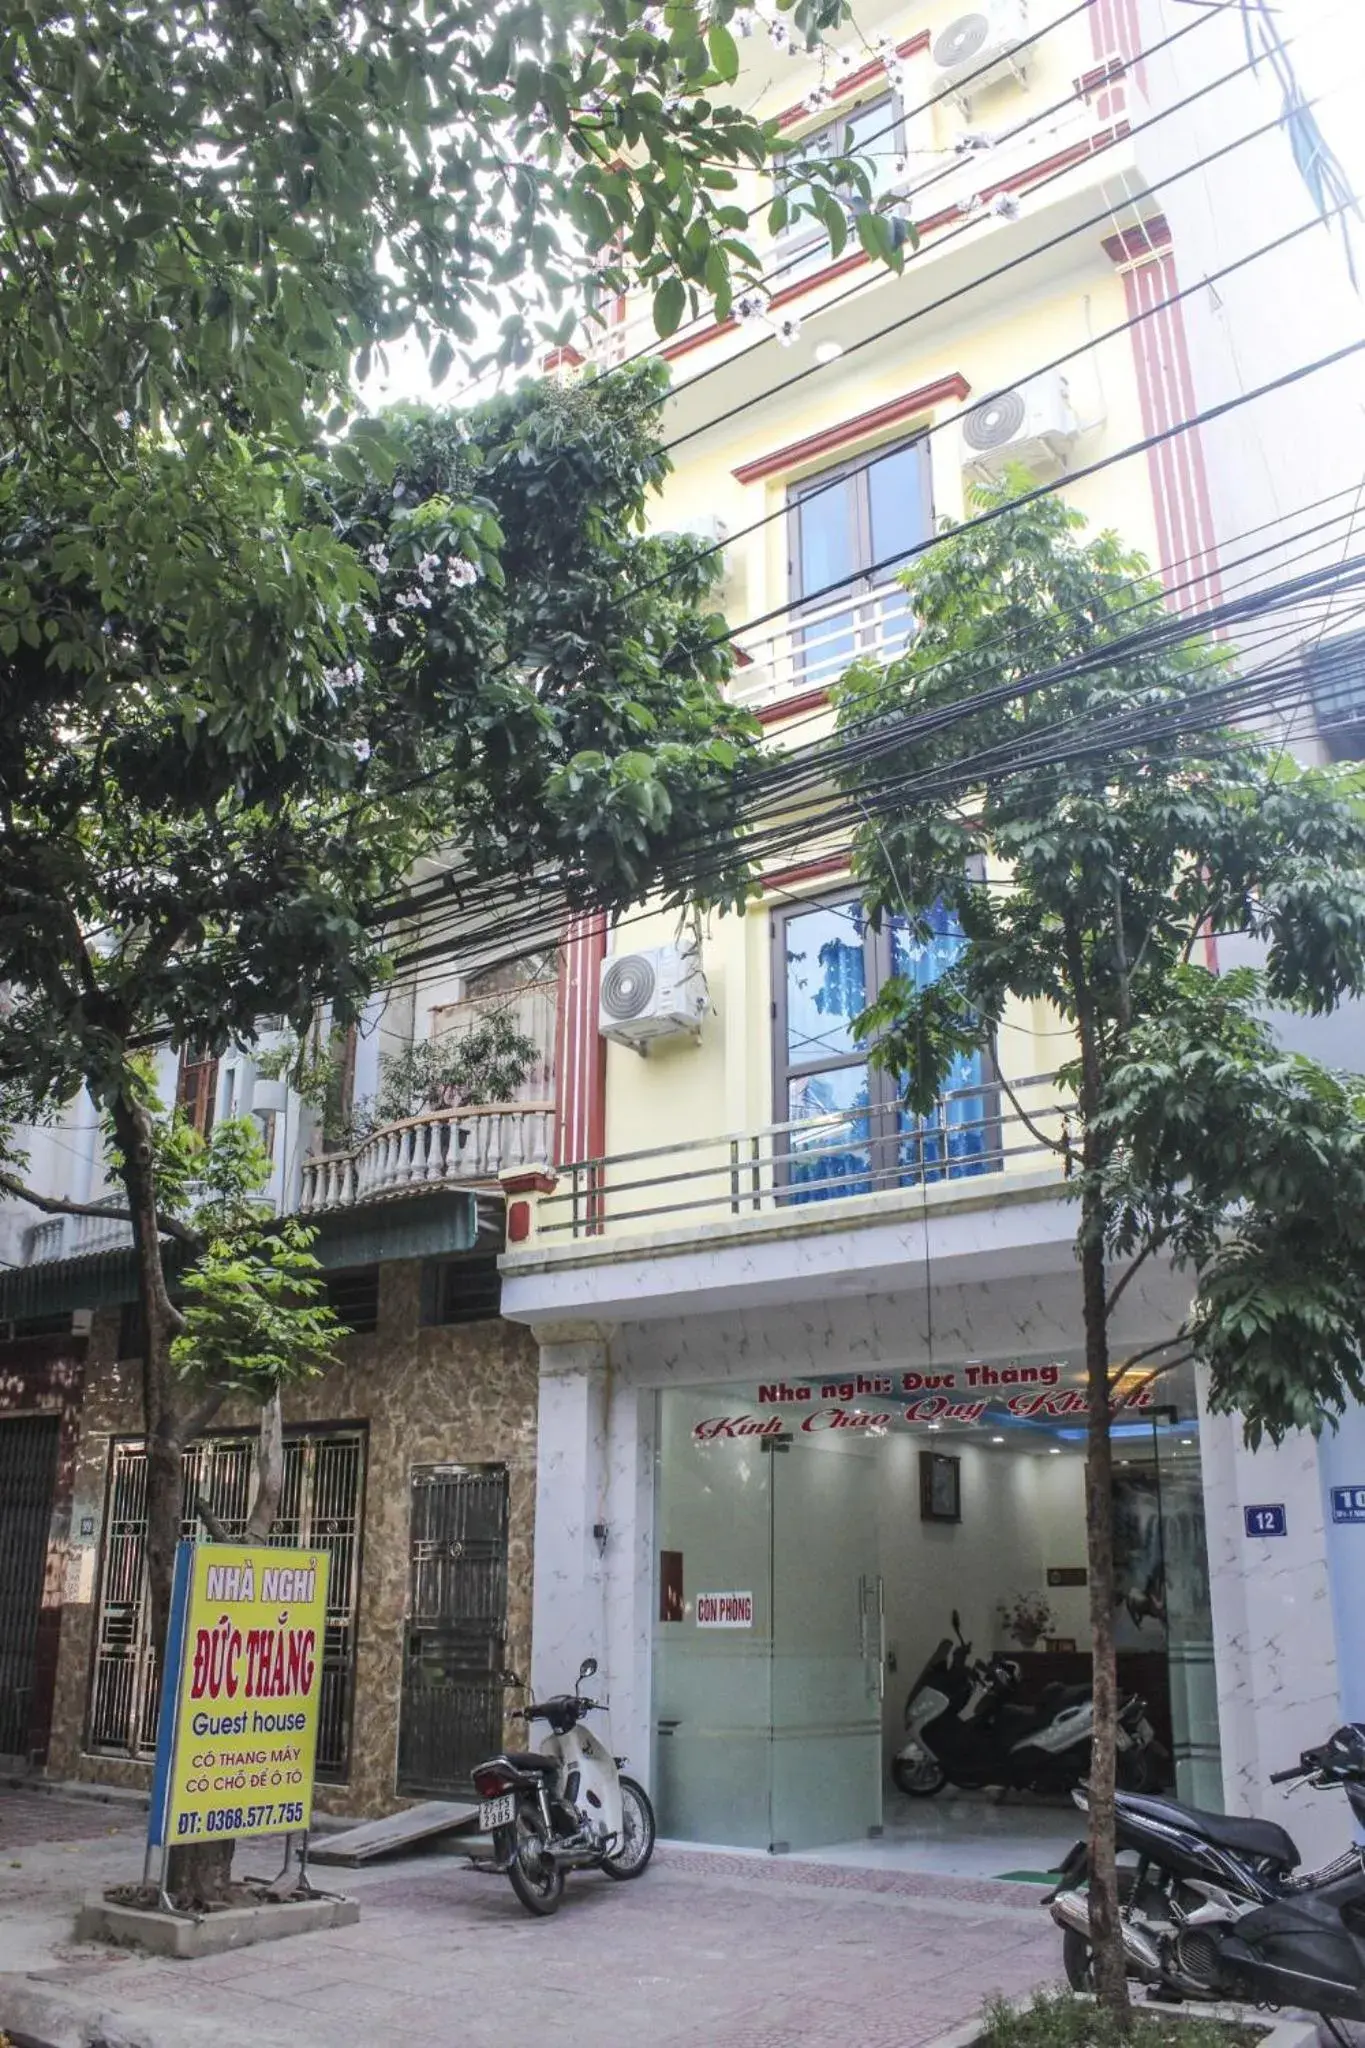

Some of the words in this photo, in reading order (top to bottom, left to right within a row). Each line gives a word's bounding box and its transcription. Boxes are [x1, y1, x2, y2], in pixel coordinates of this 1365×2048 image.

[1255, 1512, 1275, 1530] 12
[206, 1559, 255, 1602] NHÀ
[261, 1556, 318, 1603] NGHỈ
[191, 1614, 242, 1699] ĐỨC
[245, 1610, 315, 1698] THẮNG
[192, 1711, 248, 1736] Guest
[252, 1710, 306, 1733] house
[192, 1750, 216, 1768] CÓ
[219, 1751, 267, 1767] THANG
[270, 1745, 301, 1763] MÁY
[186, 1774, 210, 1793] CÓ
[213, 1769, 247, 1791] CHỖ
[271, 1769, 282, 1786] Ô
[286, 1768, 303, 1784] TÔ
[177, 1811, 202, 1836] ĐT:
[206, 1802, 304, 1832] 0368.577.755
